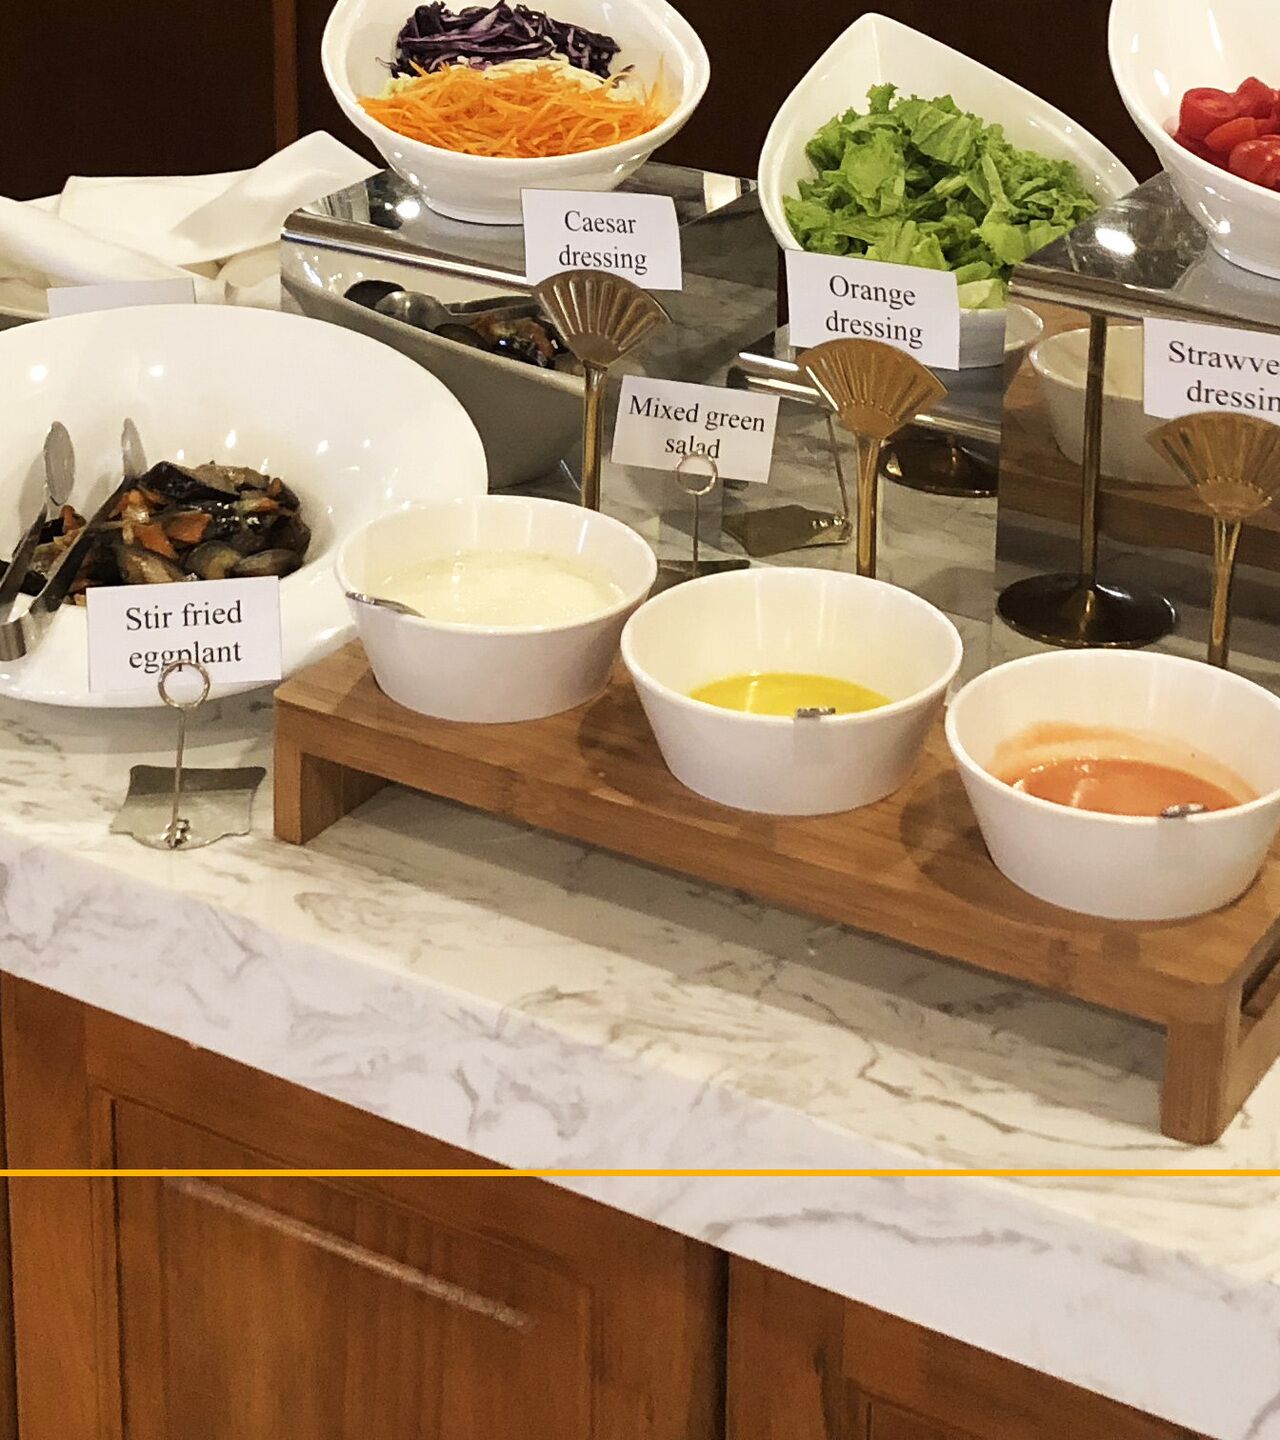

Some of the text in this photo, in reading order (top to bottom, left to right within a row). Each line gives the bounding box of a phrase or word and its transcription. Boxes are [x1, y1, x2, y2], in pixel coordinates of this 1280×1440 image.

[564, 209, 637, 235] Caesar
[558, 244, 648, 276] dressing
[829, 274, 917, 311] Orange
[825, 310, 924, 350] dressing
[629, 395, 766, 433] Mixed green
[664, 435, 721, 460] salad
[125, 599, 243, 632] Stir fried
[128, 640, 244, 674] eggplant
